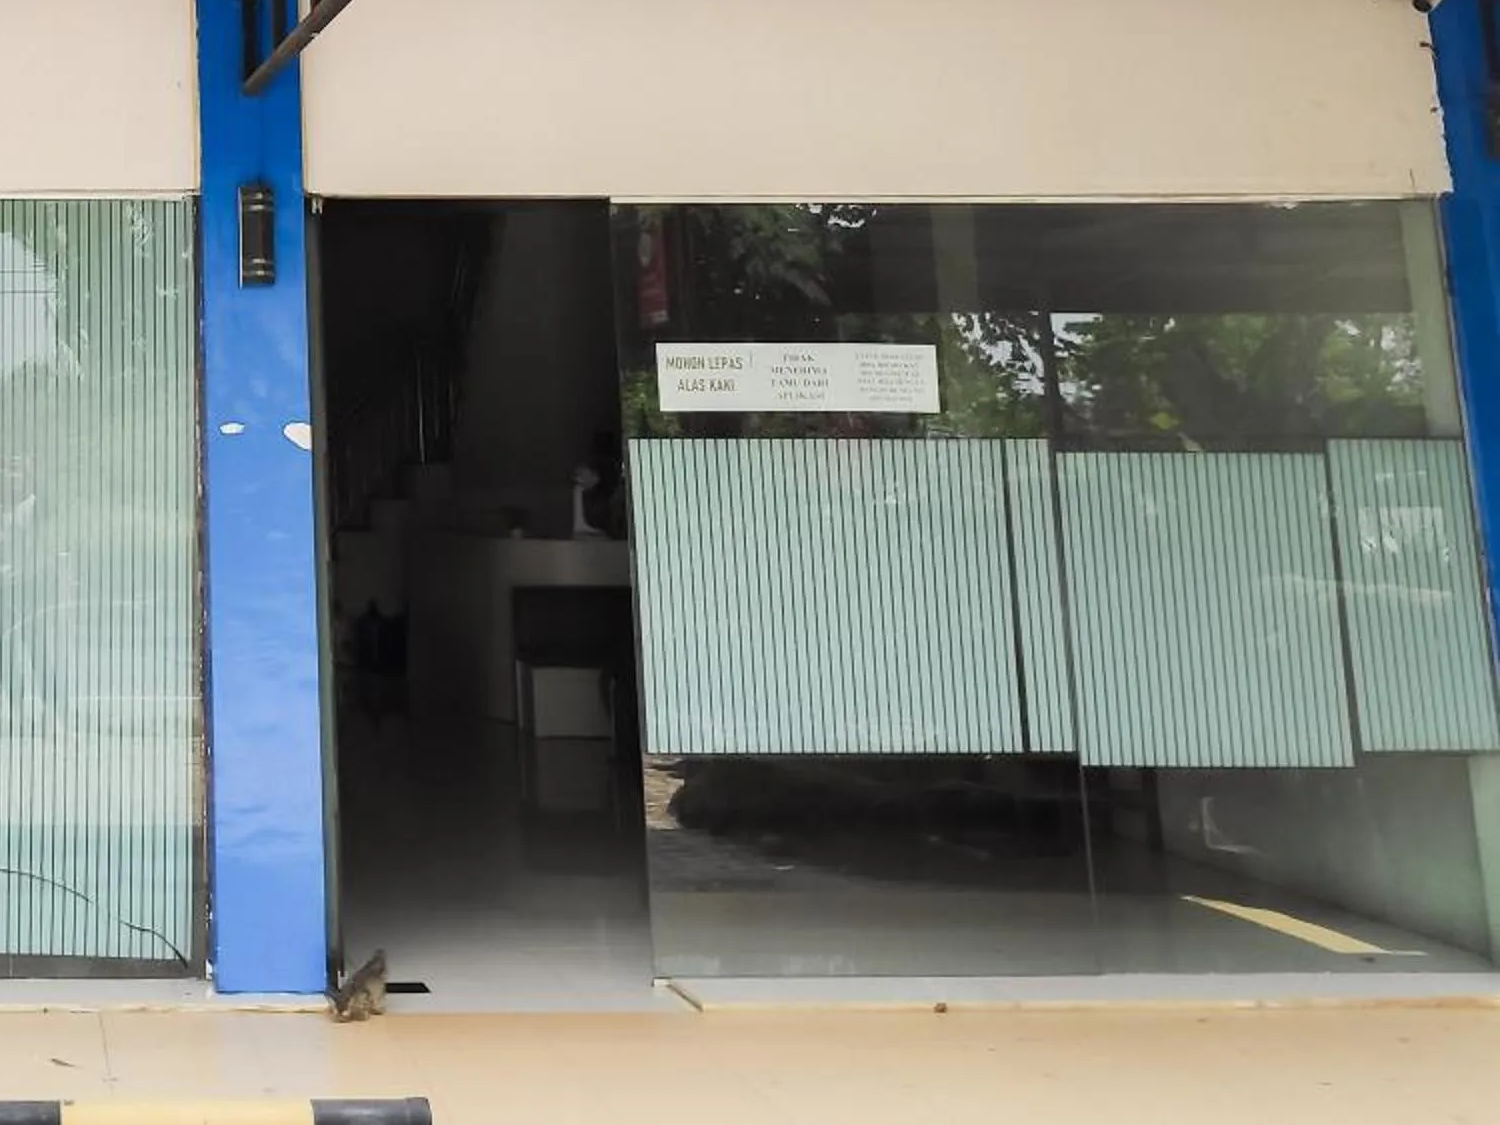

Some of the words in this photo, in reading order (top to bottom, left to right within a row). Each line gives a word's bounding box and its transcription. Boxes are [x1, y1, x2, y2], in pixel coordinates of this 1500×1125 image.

[666, 356, 705, 370] MOHON
[708, 356, 743, 370] LEPAS
[677, 378, 705, 392] ALAS
[709, 378, 736, 392] KAKI
